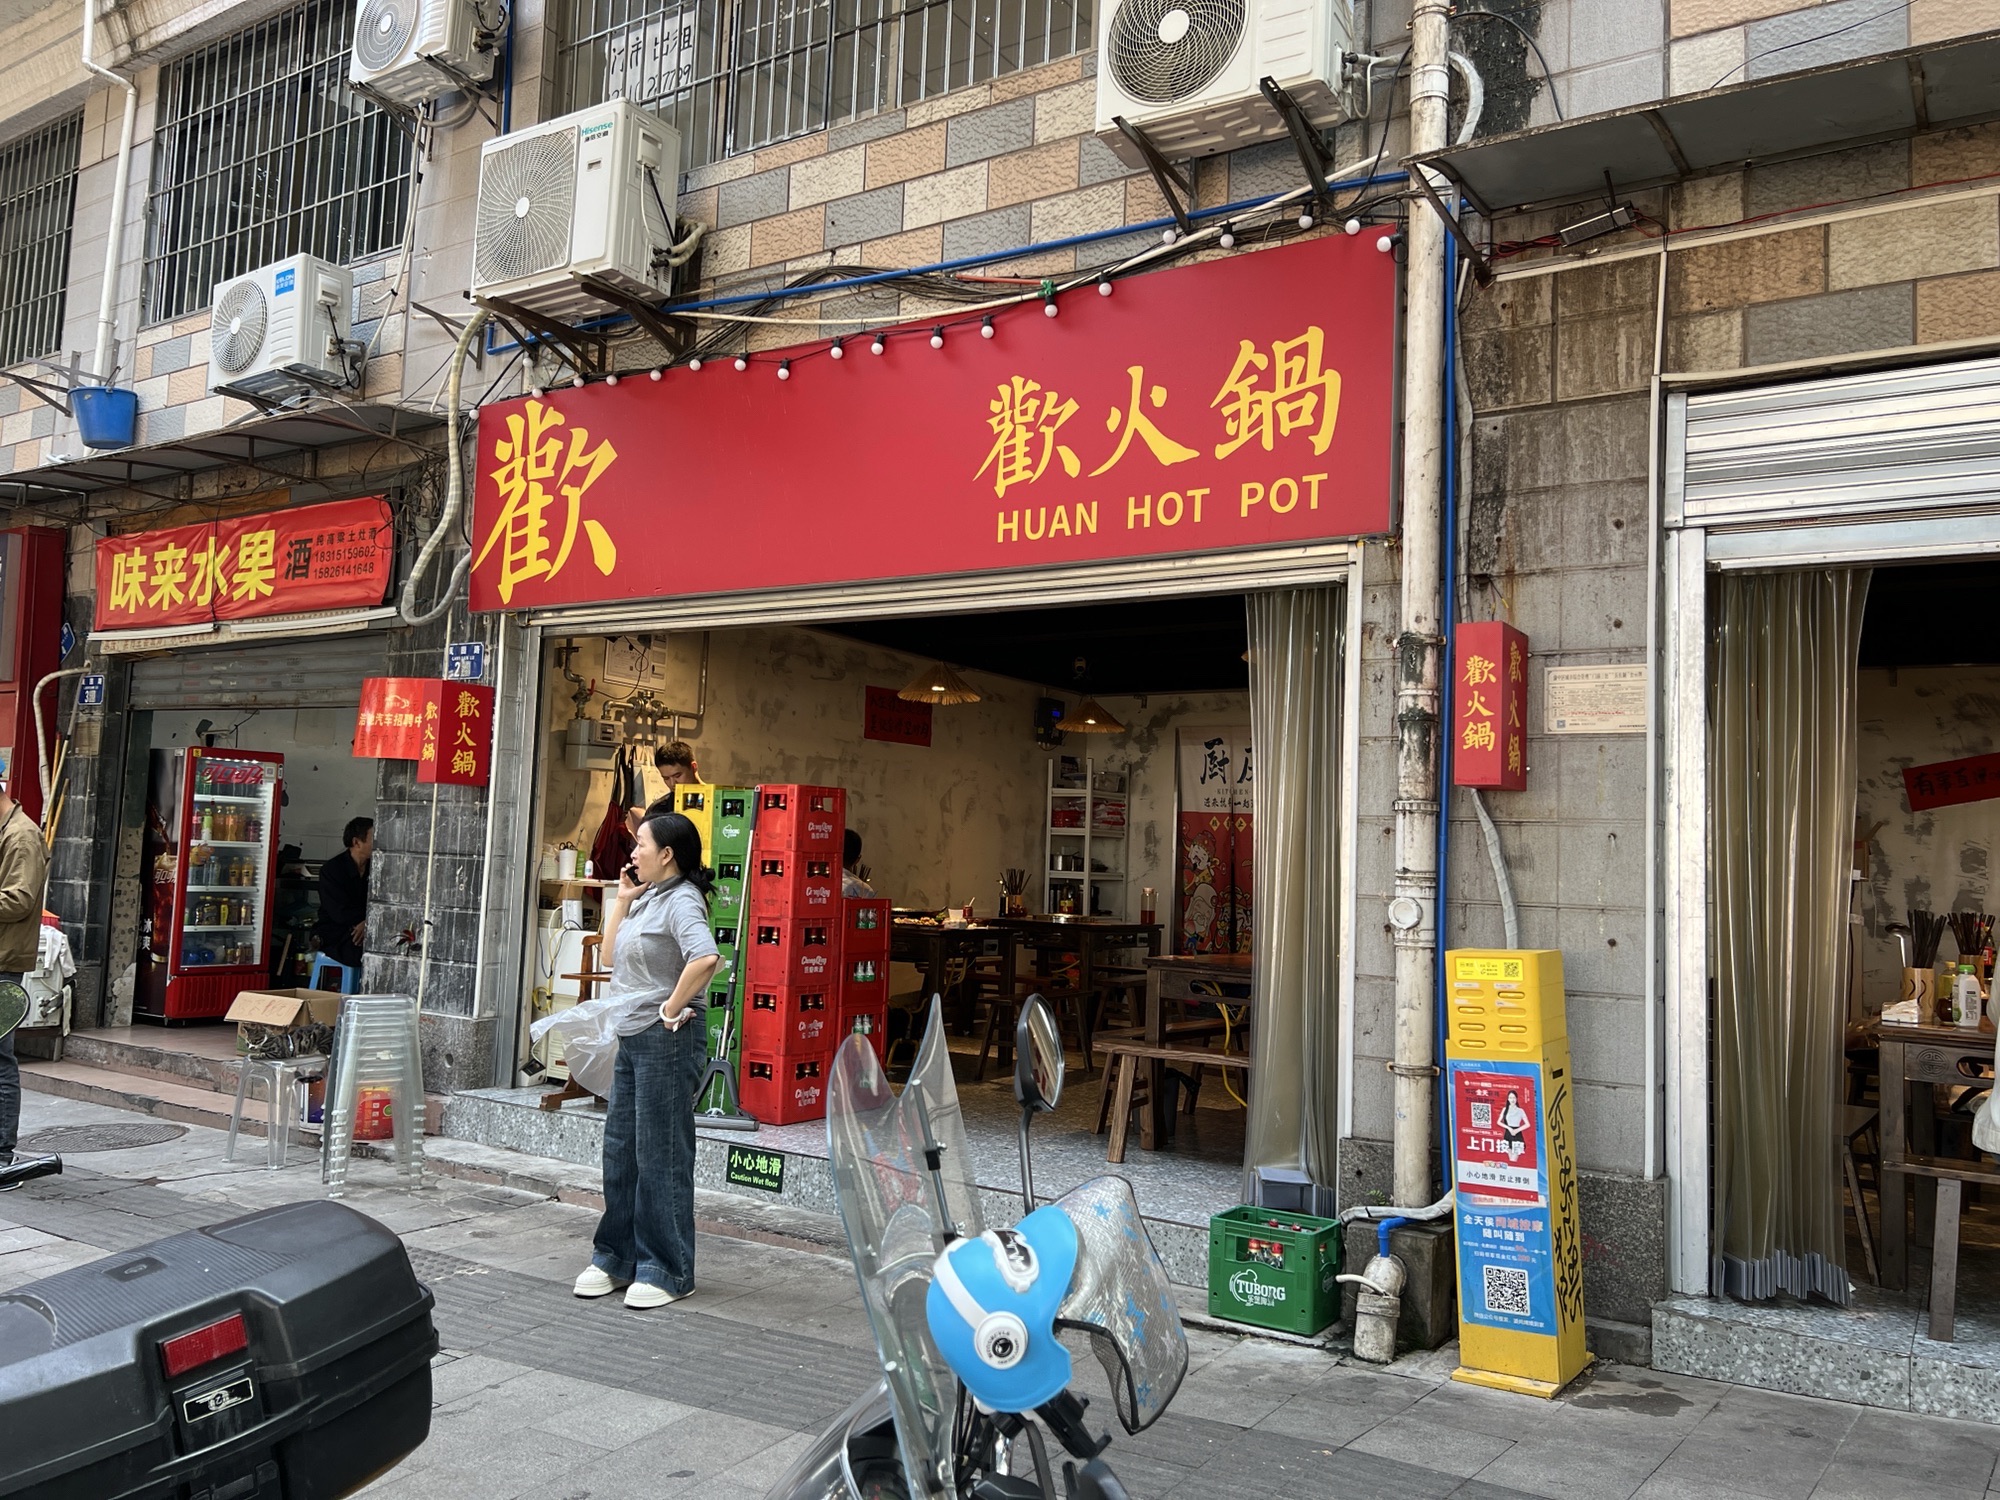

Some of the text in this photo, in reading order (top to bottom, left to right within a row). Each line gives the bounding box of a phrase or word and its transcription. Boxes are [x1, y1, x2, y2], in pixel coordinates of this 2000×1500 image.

[582, 122, 613, 136] Hisense
[972, 326, 1342, 498] 歡火鍋
[470, 400, 618, 605] 歡
[997, 473, 1328, 543] HUAN HOT POT
[284, 538, 313, 580] 酒
[315, 545, 376, 563] 18315159602
[109, 529, 276, 614] 味来水果
[314, 562, 374, 579] 15826141648
[1461, 655, 1496, 751] 歡火鍋
[1508, 640, 1522, 776] 歡火鍋
[451, 690, 480, 778] 歡火鍋
[1466, 1136, 1525, 1156] 上门按摩
[730, 1150, 782, 1176] 小心地滑
[1466, 1170, 1496, 1180] 小心地滑
[730, 1171, 751, 1182] Caution
[753, 1176, 764, 1185] Wet
[1482, 1228, 1524, 1242] 随叫随到
[1236, 1279, 1286, 1301] TUBORG
